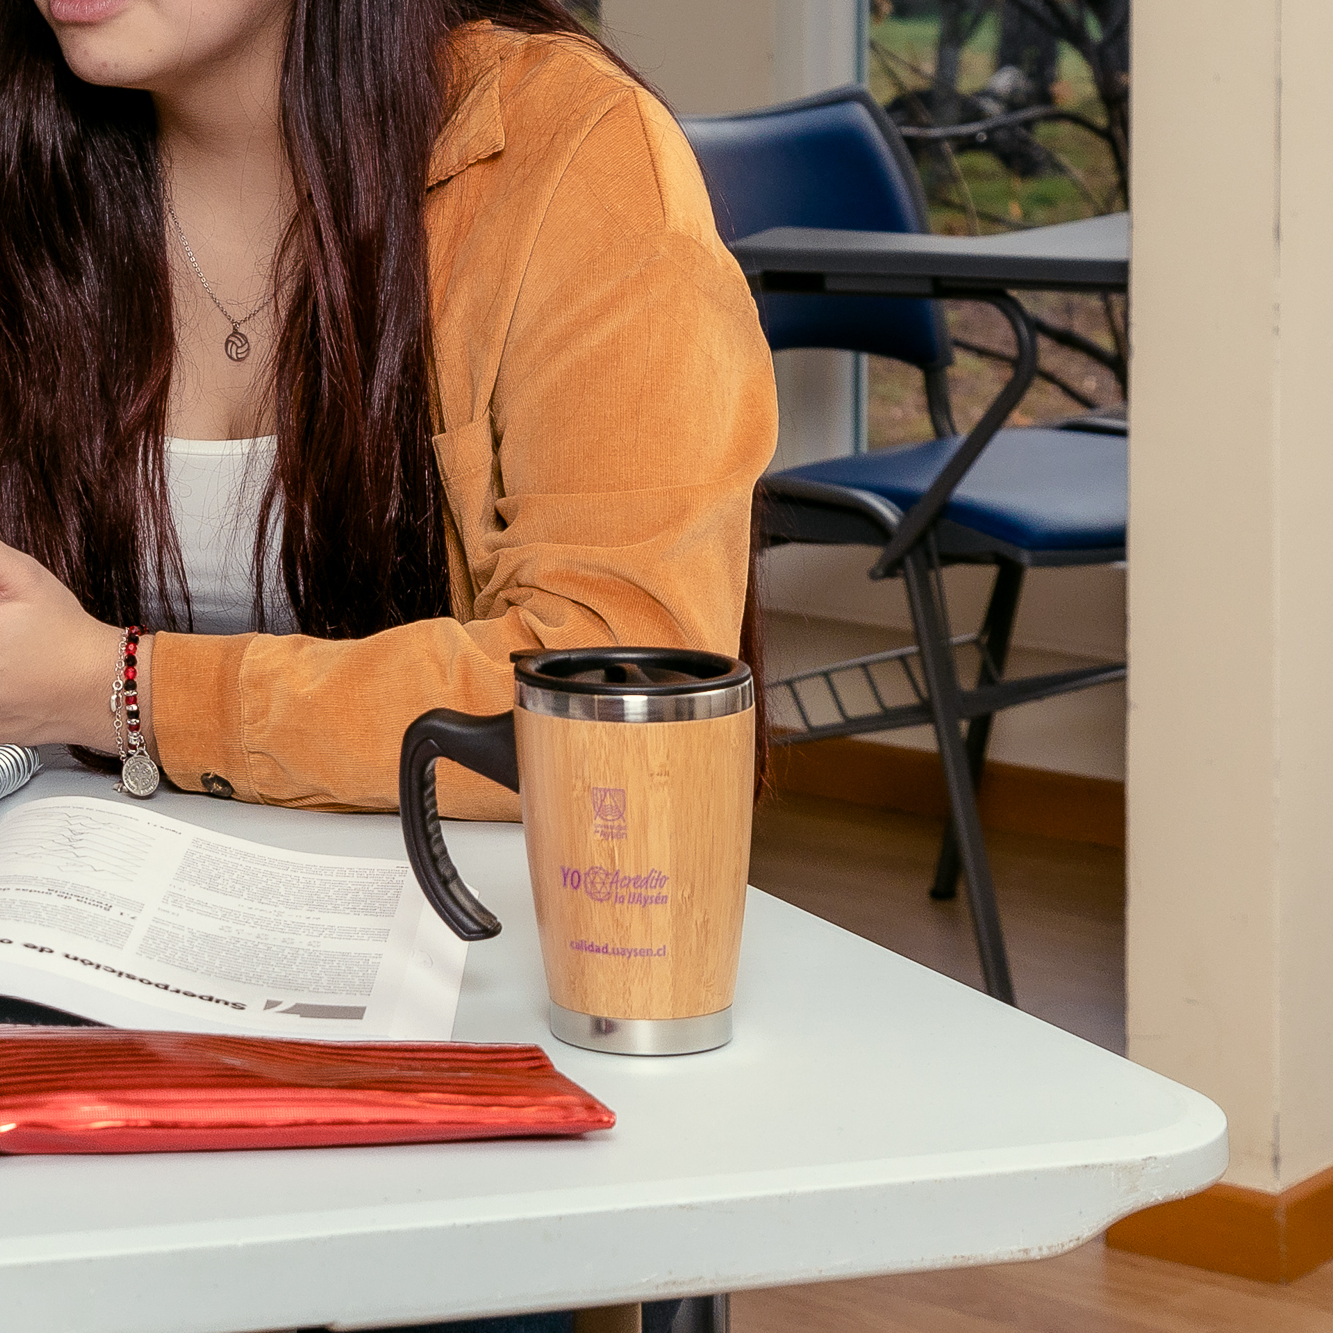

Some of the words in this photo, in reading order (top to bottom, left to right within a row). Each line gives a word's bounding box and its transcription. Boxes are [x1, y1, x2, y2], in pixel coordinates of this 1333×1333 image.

[561, 866, 582, 891] YO
[610, 868, 670, 890] Acredito
[614, 892, 626, 905] la
[627, 892, 669, 908] UAysén
[22, 942, 56, 955] de
[570, 939, 667, 960] calidad.uaysen.cl
[62, 952, 248, 1012] Superposición
